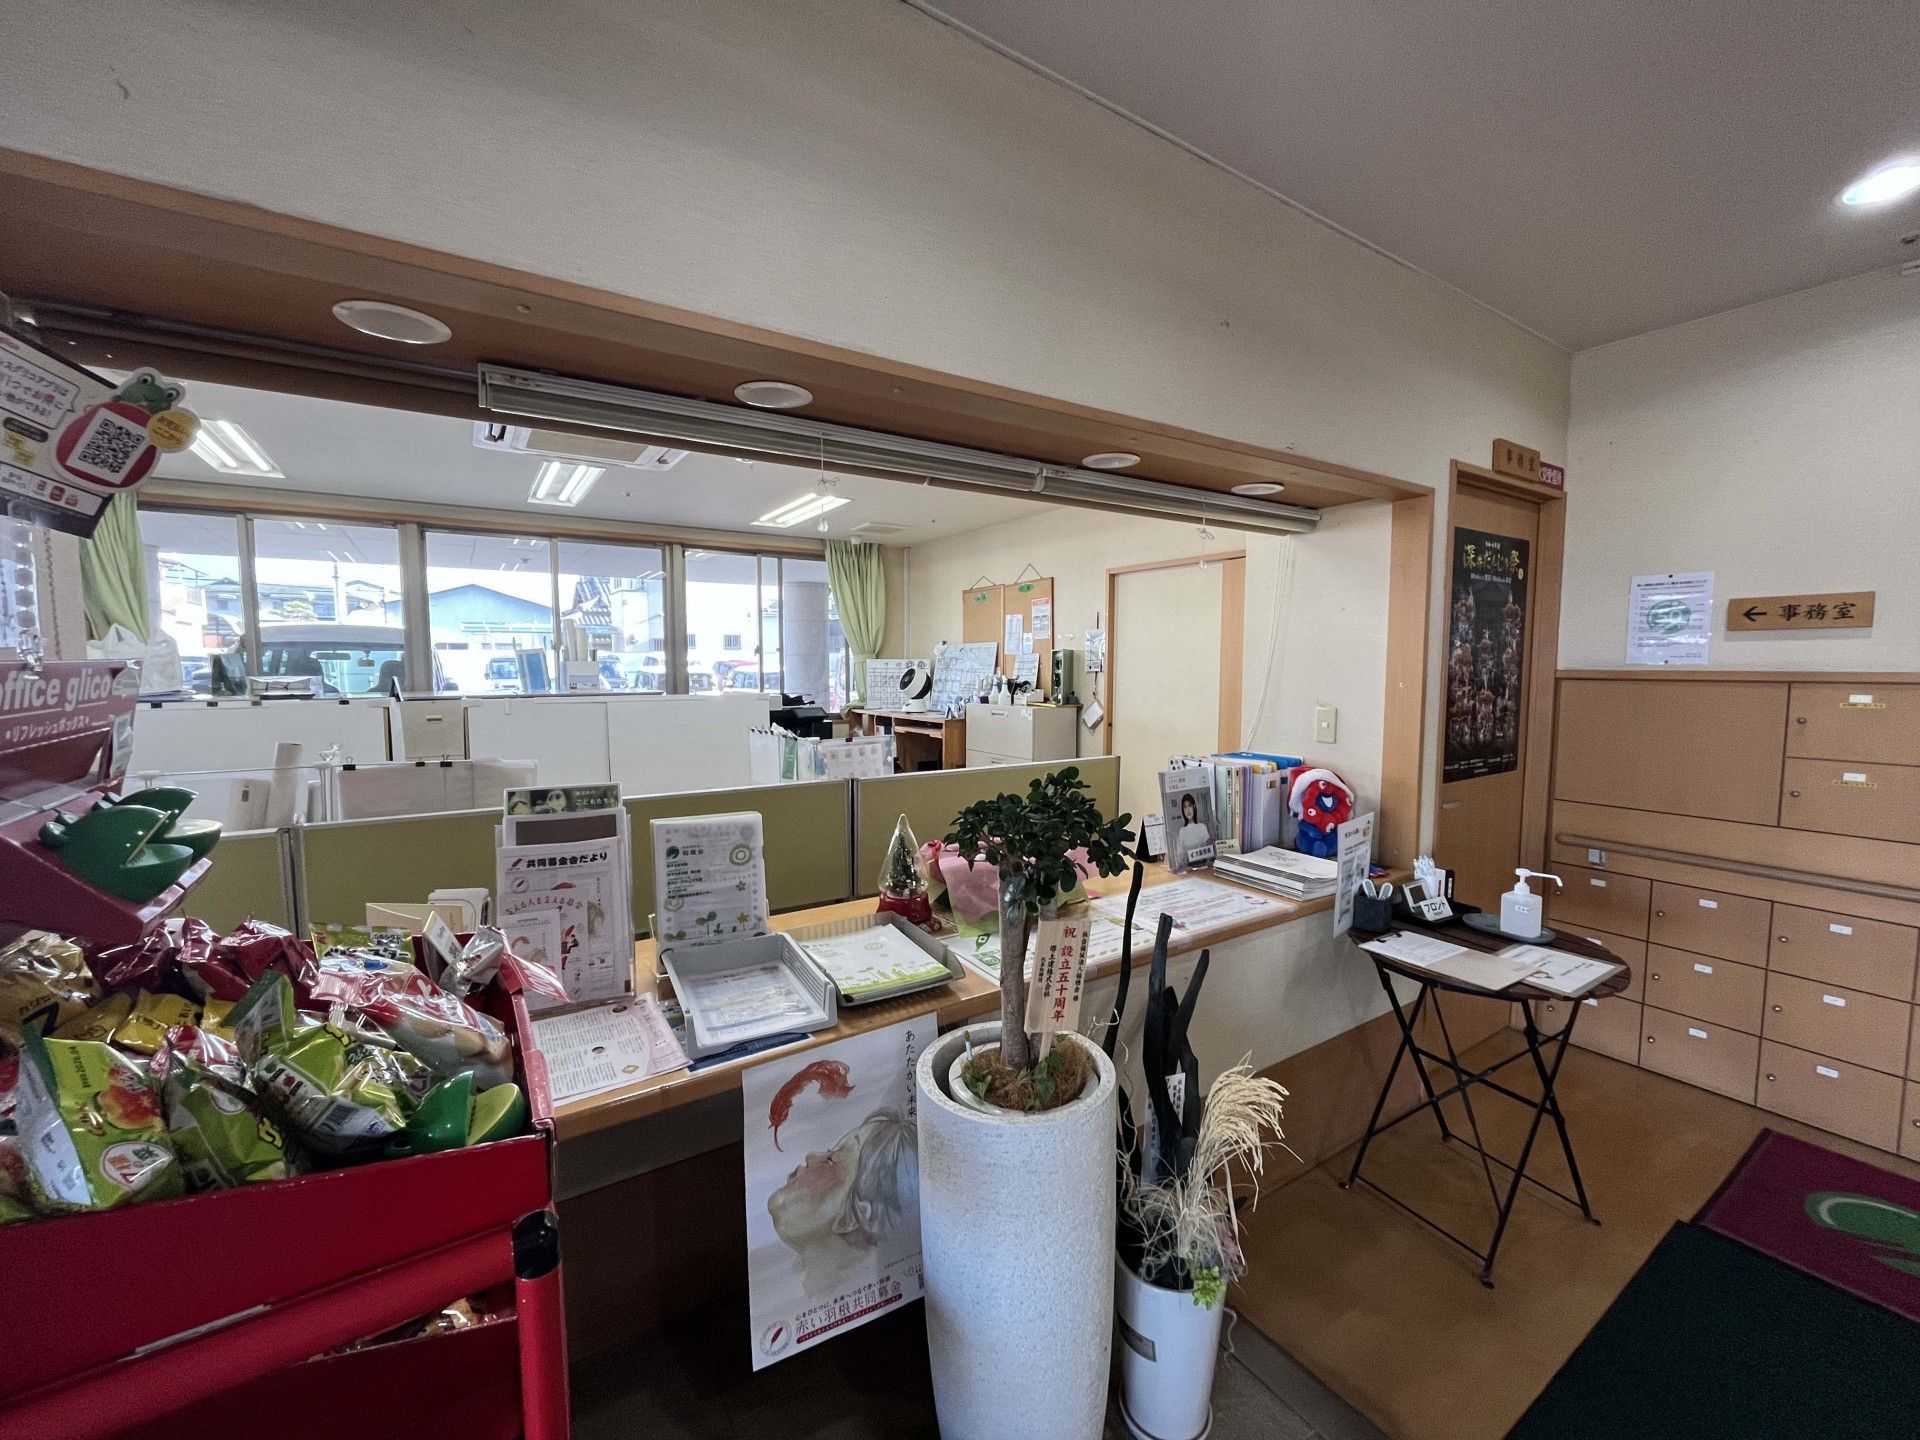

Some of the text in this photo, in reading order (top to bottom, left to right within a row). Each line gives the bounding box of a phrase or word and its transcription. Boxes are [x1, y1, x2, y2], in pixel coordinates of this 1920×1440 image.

[1779, 601, 1856, 621] 事務室
[0, 668, 111, 711] ffice glico
[526, 852, 608, 869] 共同募金会だより
[1424, 900, 1446, 912] フロント
[1051, 926, 1077, 1022] 祝 設立五十周年
[796, 1281, 903, 1336] 赤い羽根共同募金
